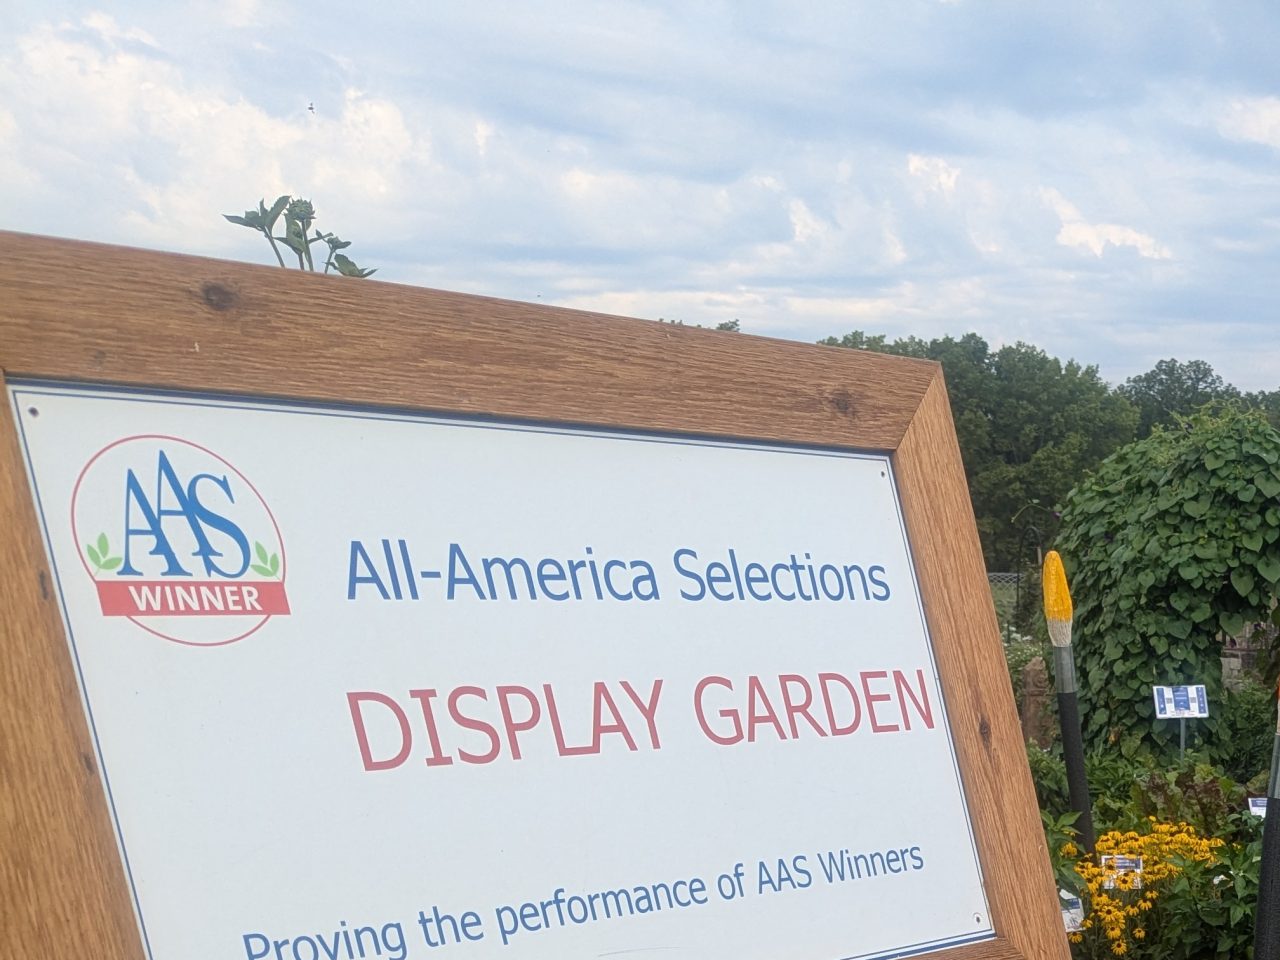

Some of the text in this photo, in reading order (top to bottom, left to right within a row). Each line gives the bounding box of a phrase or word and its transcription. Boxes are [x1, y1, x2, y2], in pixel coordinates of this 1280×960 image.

[117, 449, 251, 578] AAS
[128, 585, 263, 612] WINNER
[347, 539, 892, 602] All-America Selections
[347, 670, 935, 771] DISPLAY GARDEN
[418, 905, 482, 948] the
[496, 878, 708, 945] performance
[717, 863, 745, 900] of
[757, 855, 812, 894] AAS
[816, 846, 924, 884] Winners
